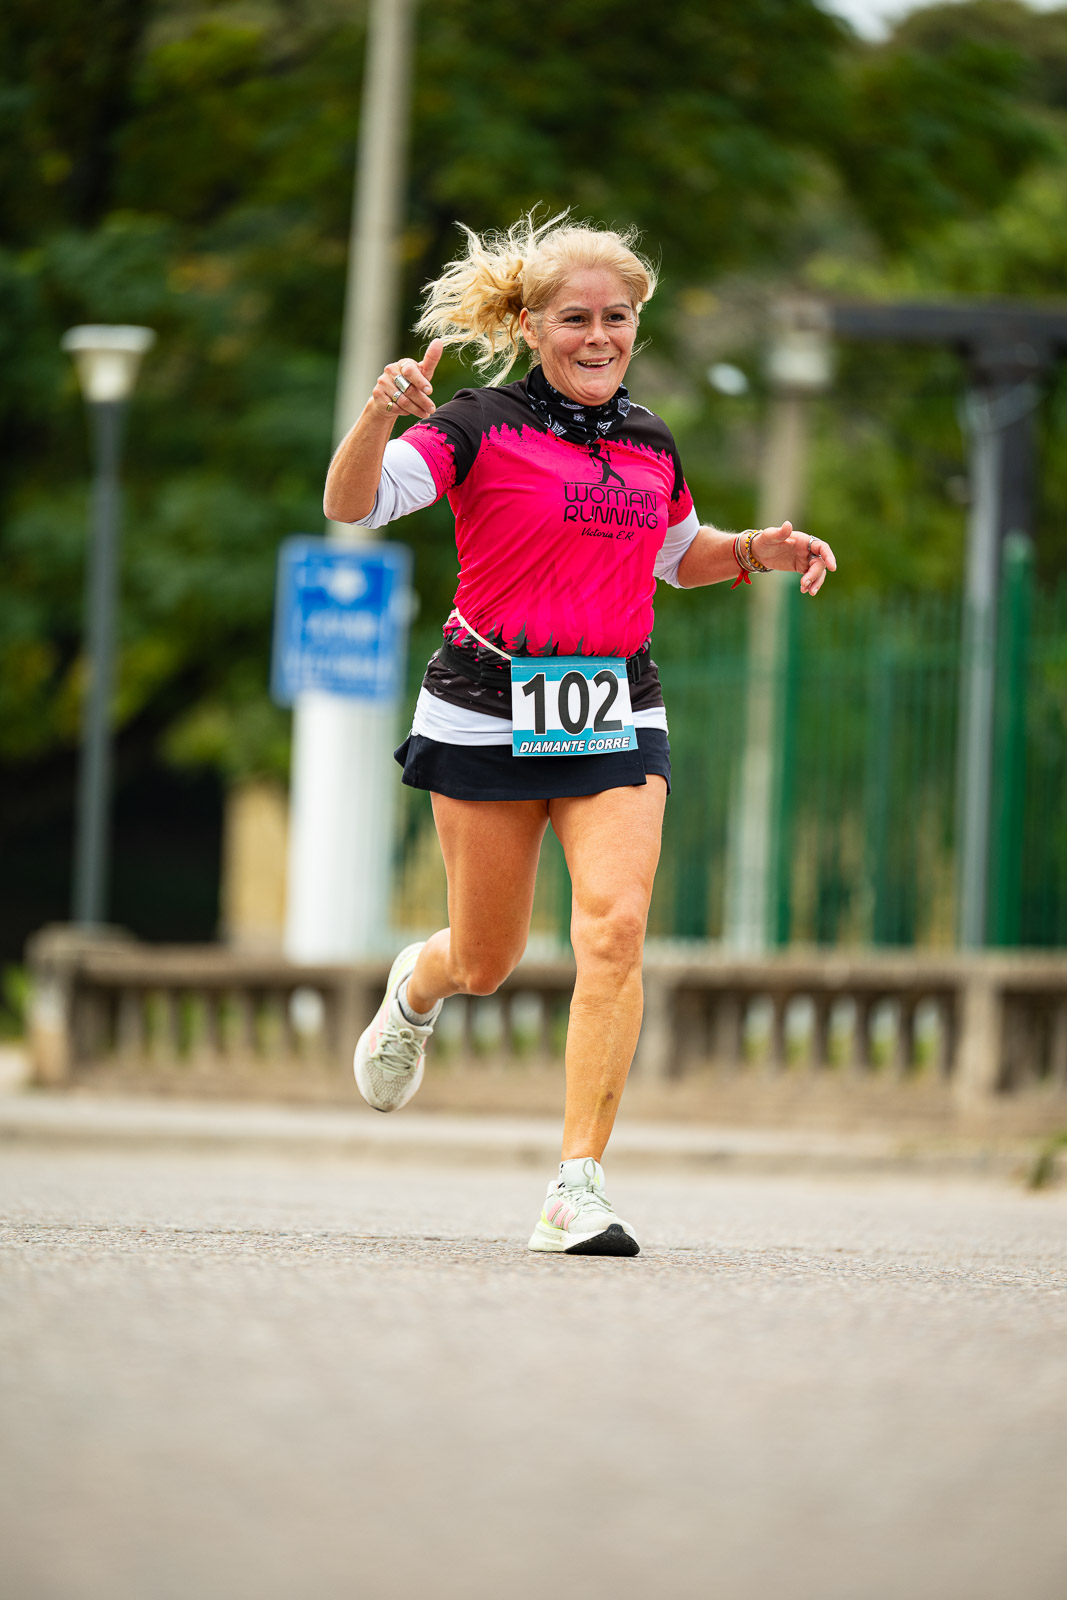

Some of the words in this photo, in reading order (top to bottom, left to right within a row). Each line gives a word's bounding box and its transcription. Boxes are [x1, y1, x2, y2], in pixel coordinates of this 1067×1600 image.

[564, 485, 657, 511] WOMAN
[563, 504, 658, 529] RUNNING
[581, 526, 613, 539] Victoria
[616, 530, 634, 541] E.R.
[521, 669, 624, 735] 102
[519, 740, 585, 753] DIAMANTE
[587, 736, 630, 751] CORRE
